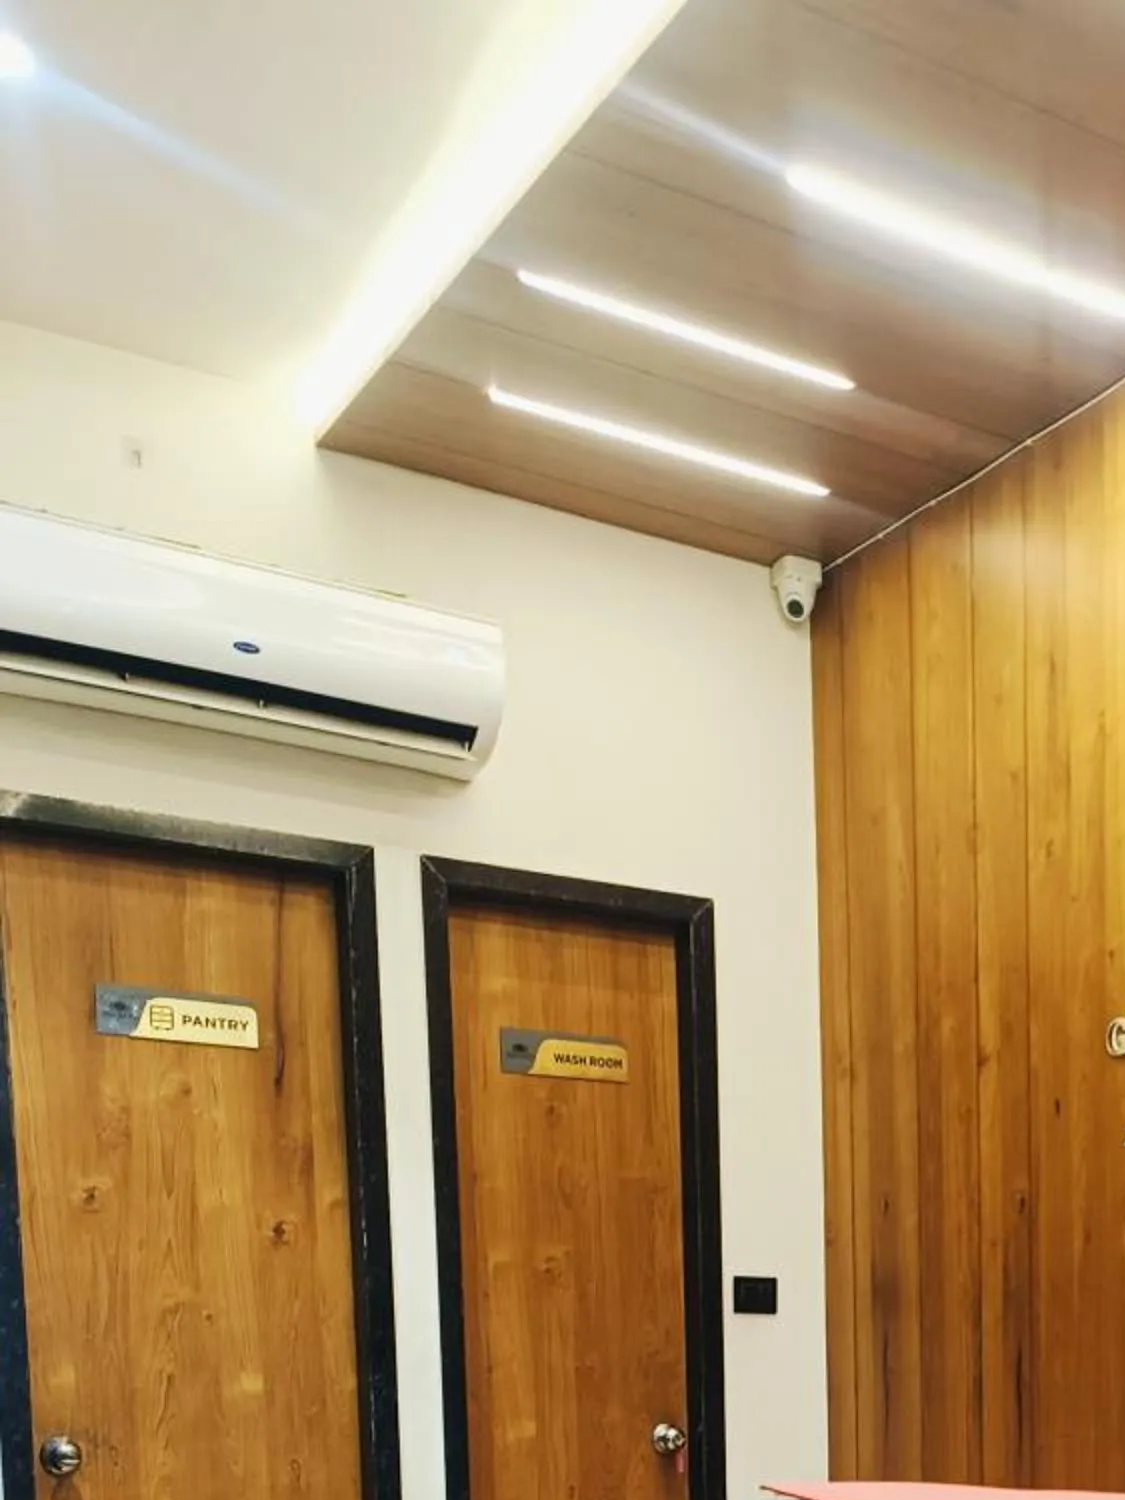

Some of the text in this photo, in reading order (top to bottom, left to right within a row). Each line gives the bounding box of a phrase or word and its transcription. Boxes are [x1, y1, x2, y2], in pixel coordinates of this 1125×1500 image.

[181, 1014, 250, 1031] PANTRY
[553, 1051, 623, 1069] WASH ROOM
